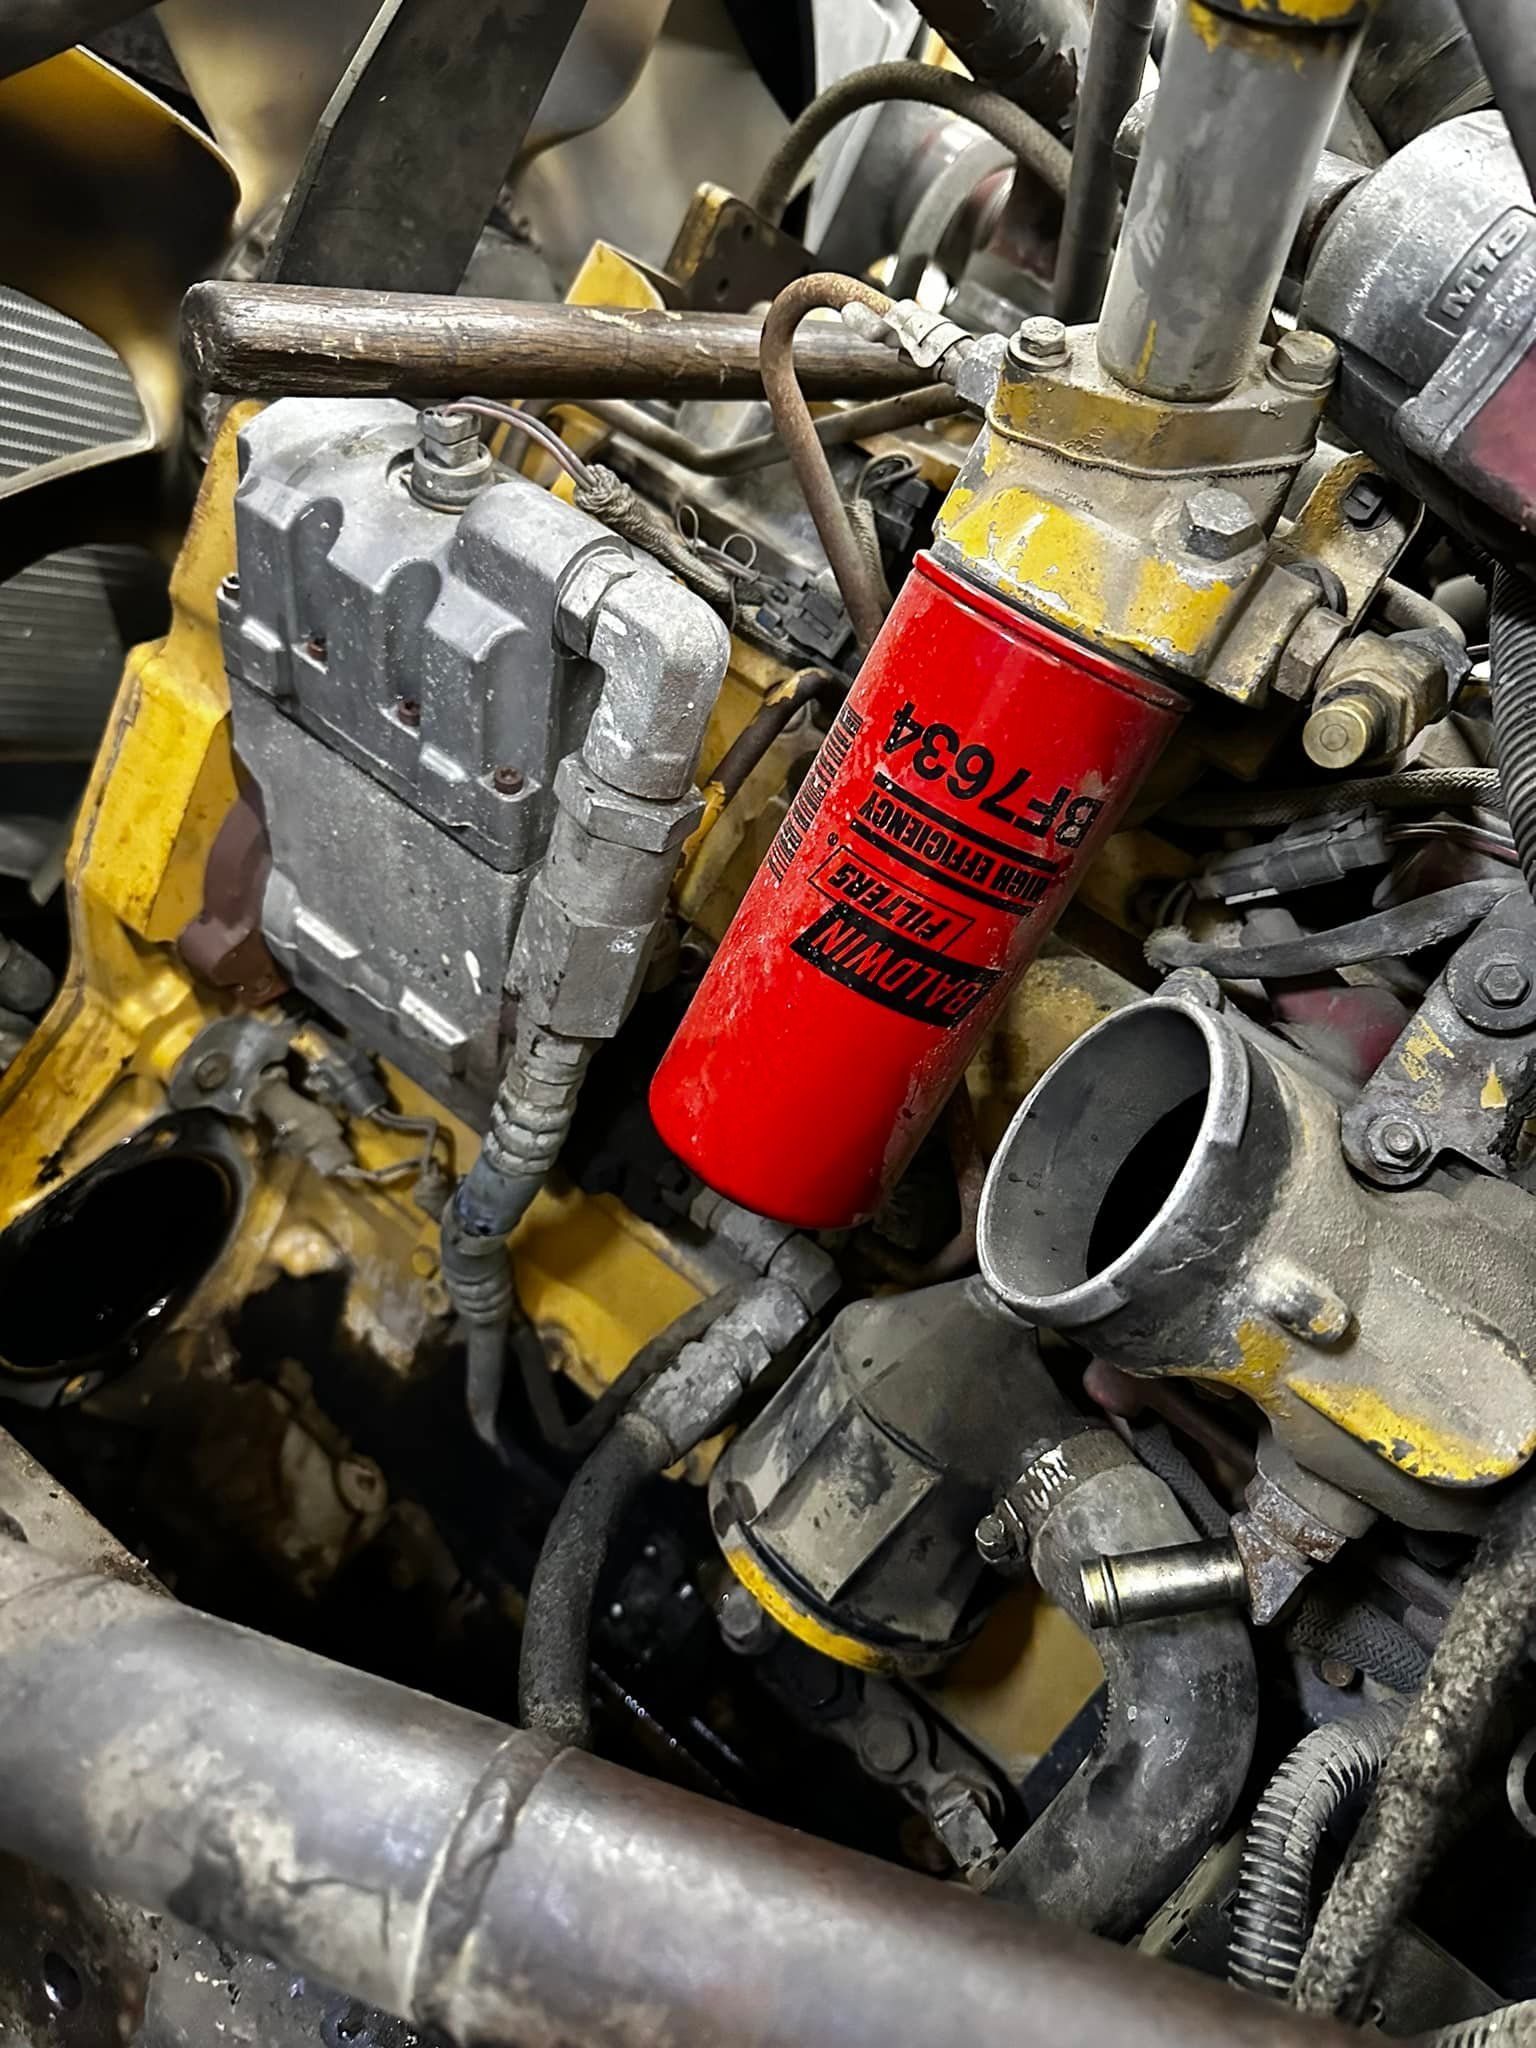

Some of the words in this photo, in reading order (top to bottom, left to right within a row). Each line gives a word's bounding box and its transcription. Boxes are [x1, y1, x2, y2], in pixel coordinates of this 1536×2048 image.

[1441, 217, 1528, 319] M18
[883, 701, 1104, 849] BF7634
[859, 790, 994, 882] EFFICIENCY
[829, 864, 950, 942] FILTERS
[994, 864, 1048, 904] HIGH
[812, 919, 983, 1016] BALDWIN
